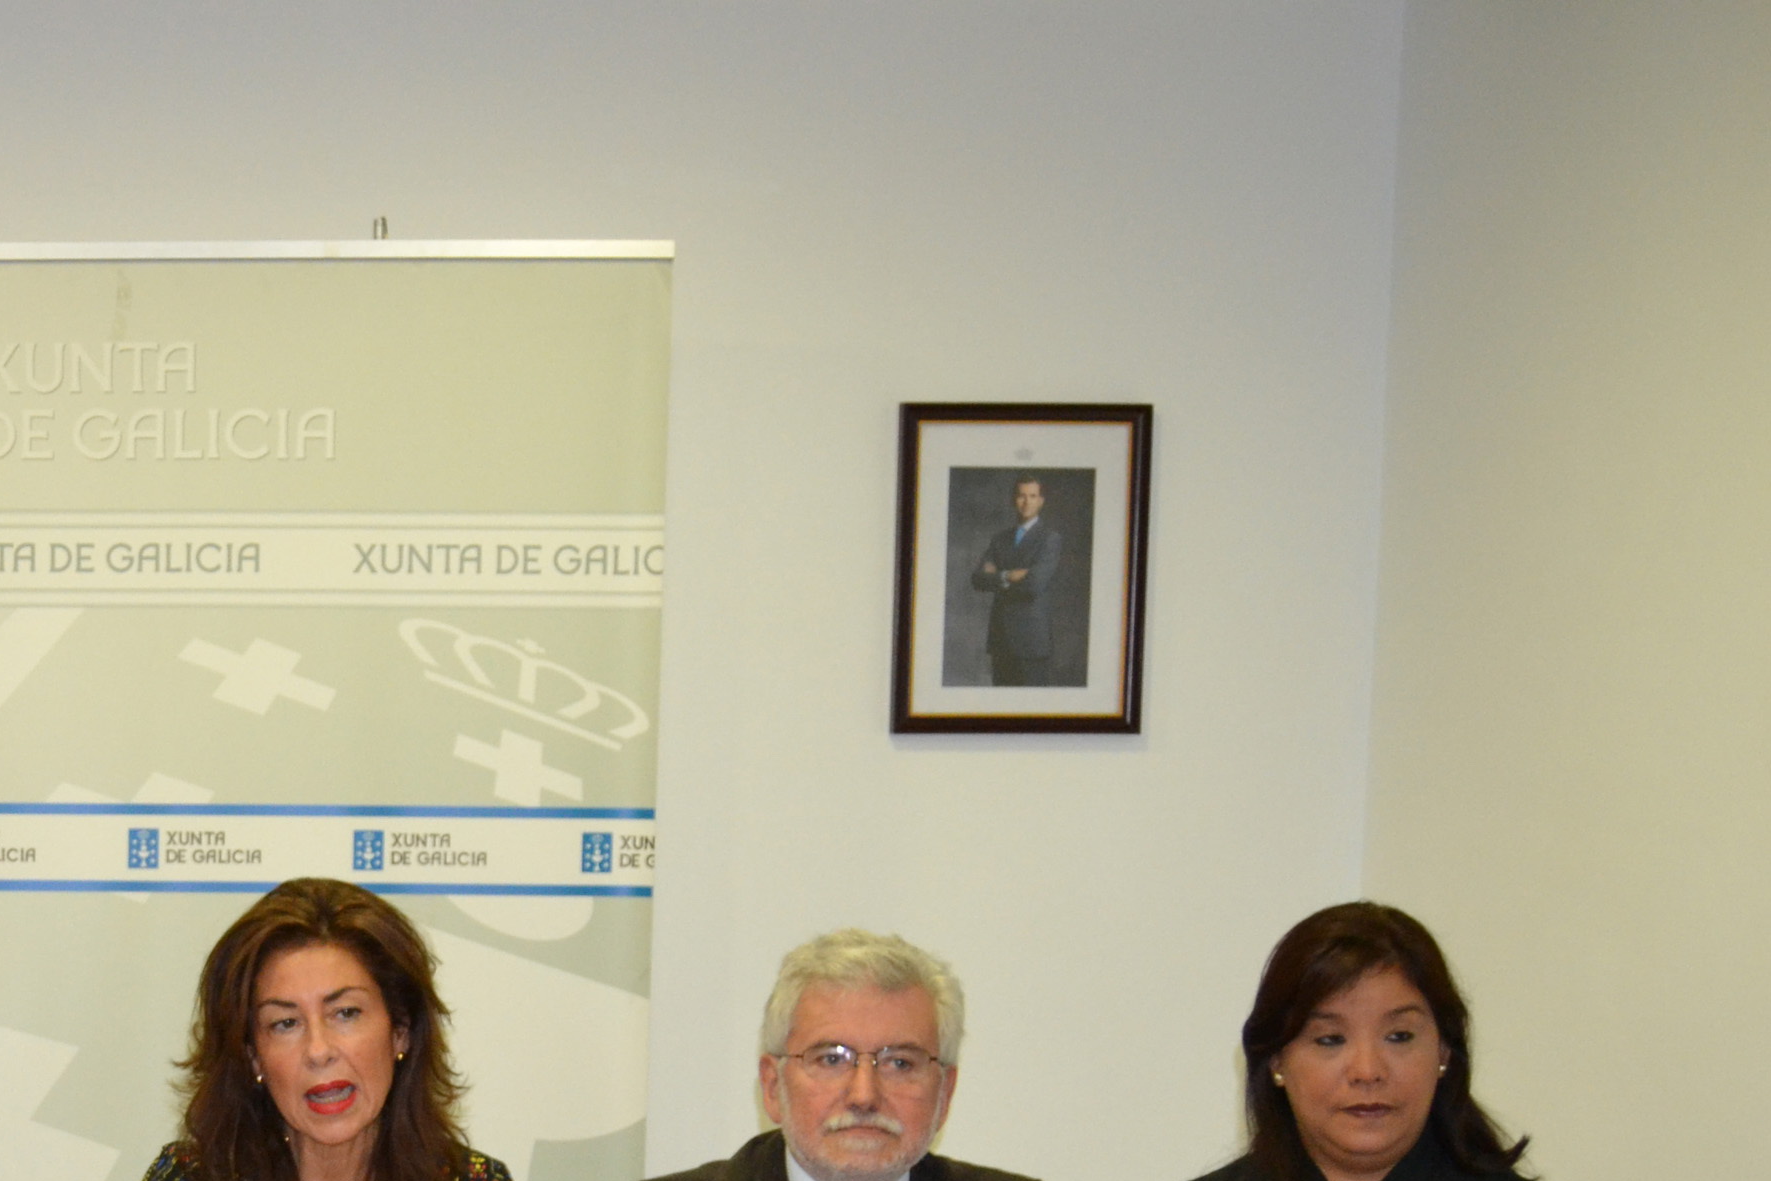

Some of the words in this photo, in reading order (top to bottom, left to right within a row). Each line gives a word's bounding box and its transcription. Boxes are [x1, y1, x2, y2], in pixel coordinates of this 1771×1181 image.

[73, 407, 337, 461] GALICIA
[48, 542, 95, 573] DE
[106, 542, 261, 574] GALICIA
[353, 544, 482, 575] XUNTA
[495, 545, 542, 575] DE
[166, 831, 225, 846] XUNTA
[391, 833, 451, 848] XUNTA
[166, 849, 187, 864] DE
[192, 849, 262, 865] GALICIA
[391, 851, 412, 866] DE
[417, 851, 488, 867] GALICIA
[619, 853, 640, 868] DE
